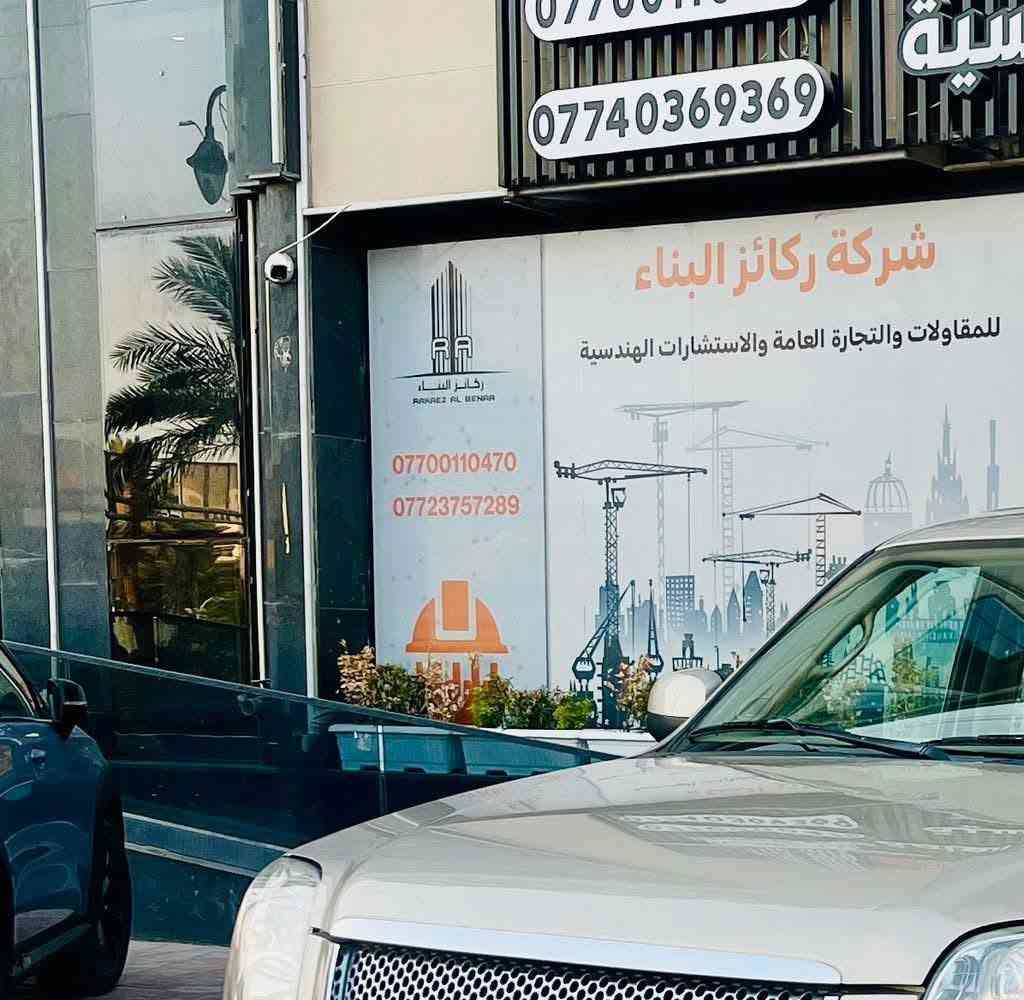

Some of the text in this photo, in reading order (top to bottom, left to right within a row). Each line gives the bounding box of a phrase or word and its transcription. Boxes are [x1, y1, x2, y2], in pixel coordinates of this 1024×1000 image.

[532, 73, 818, 146] 07740369369
[635, 223, 935, 299] شركة ركائز البناء
[579, 316, 1001, 366] للمقاولات والتجارة العامة والاستشارات الهندسية
[392, 452, 517, 475] 07700110470
[392, 494, 521, 517] 07723757289
